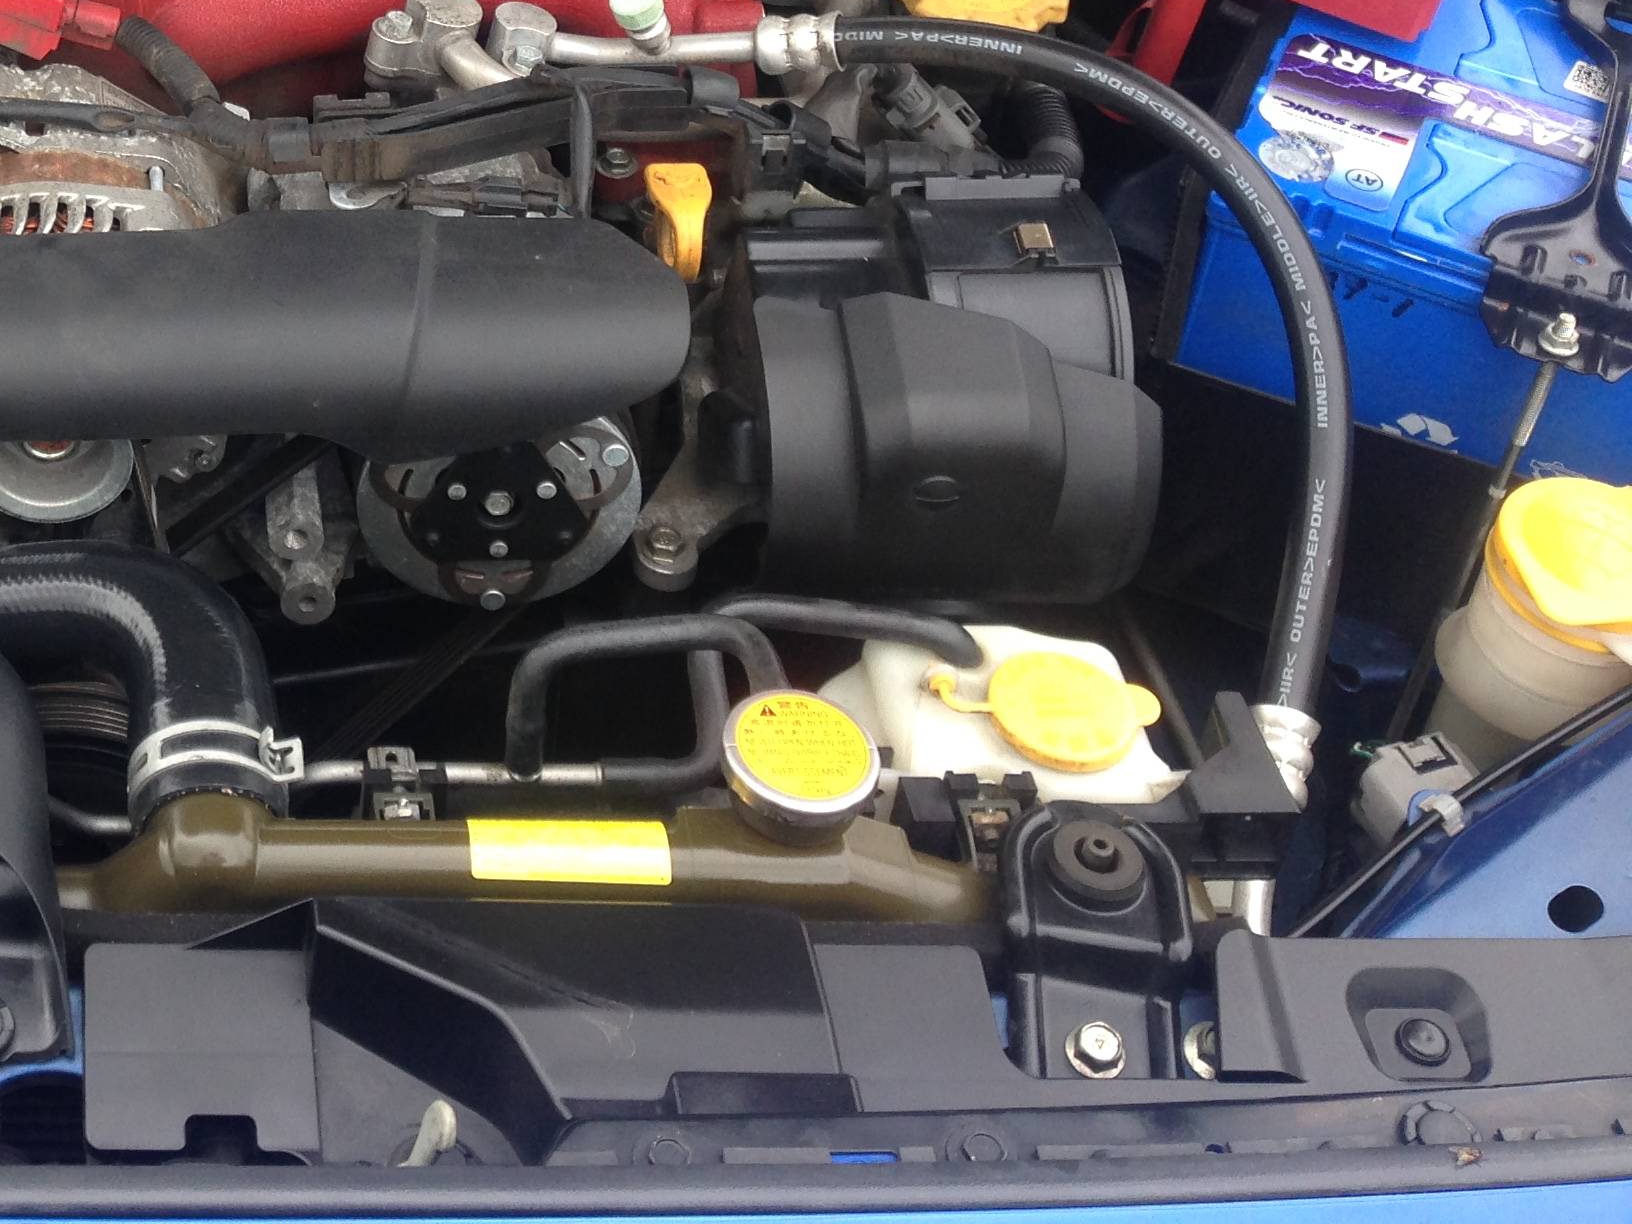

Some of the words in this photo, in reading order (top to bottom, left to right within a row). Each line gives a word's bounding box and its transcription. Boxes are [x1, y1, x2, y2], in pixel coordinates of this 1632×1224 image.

[1296, 40, 1471, 107] START
[1452, 97, 1632, 167] LASH
[1352, 173, 1378, 187] AT
